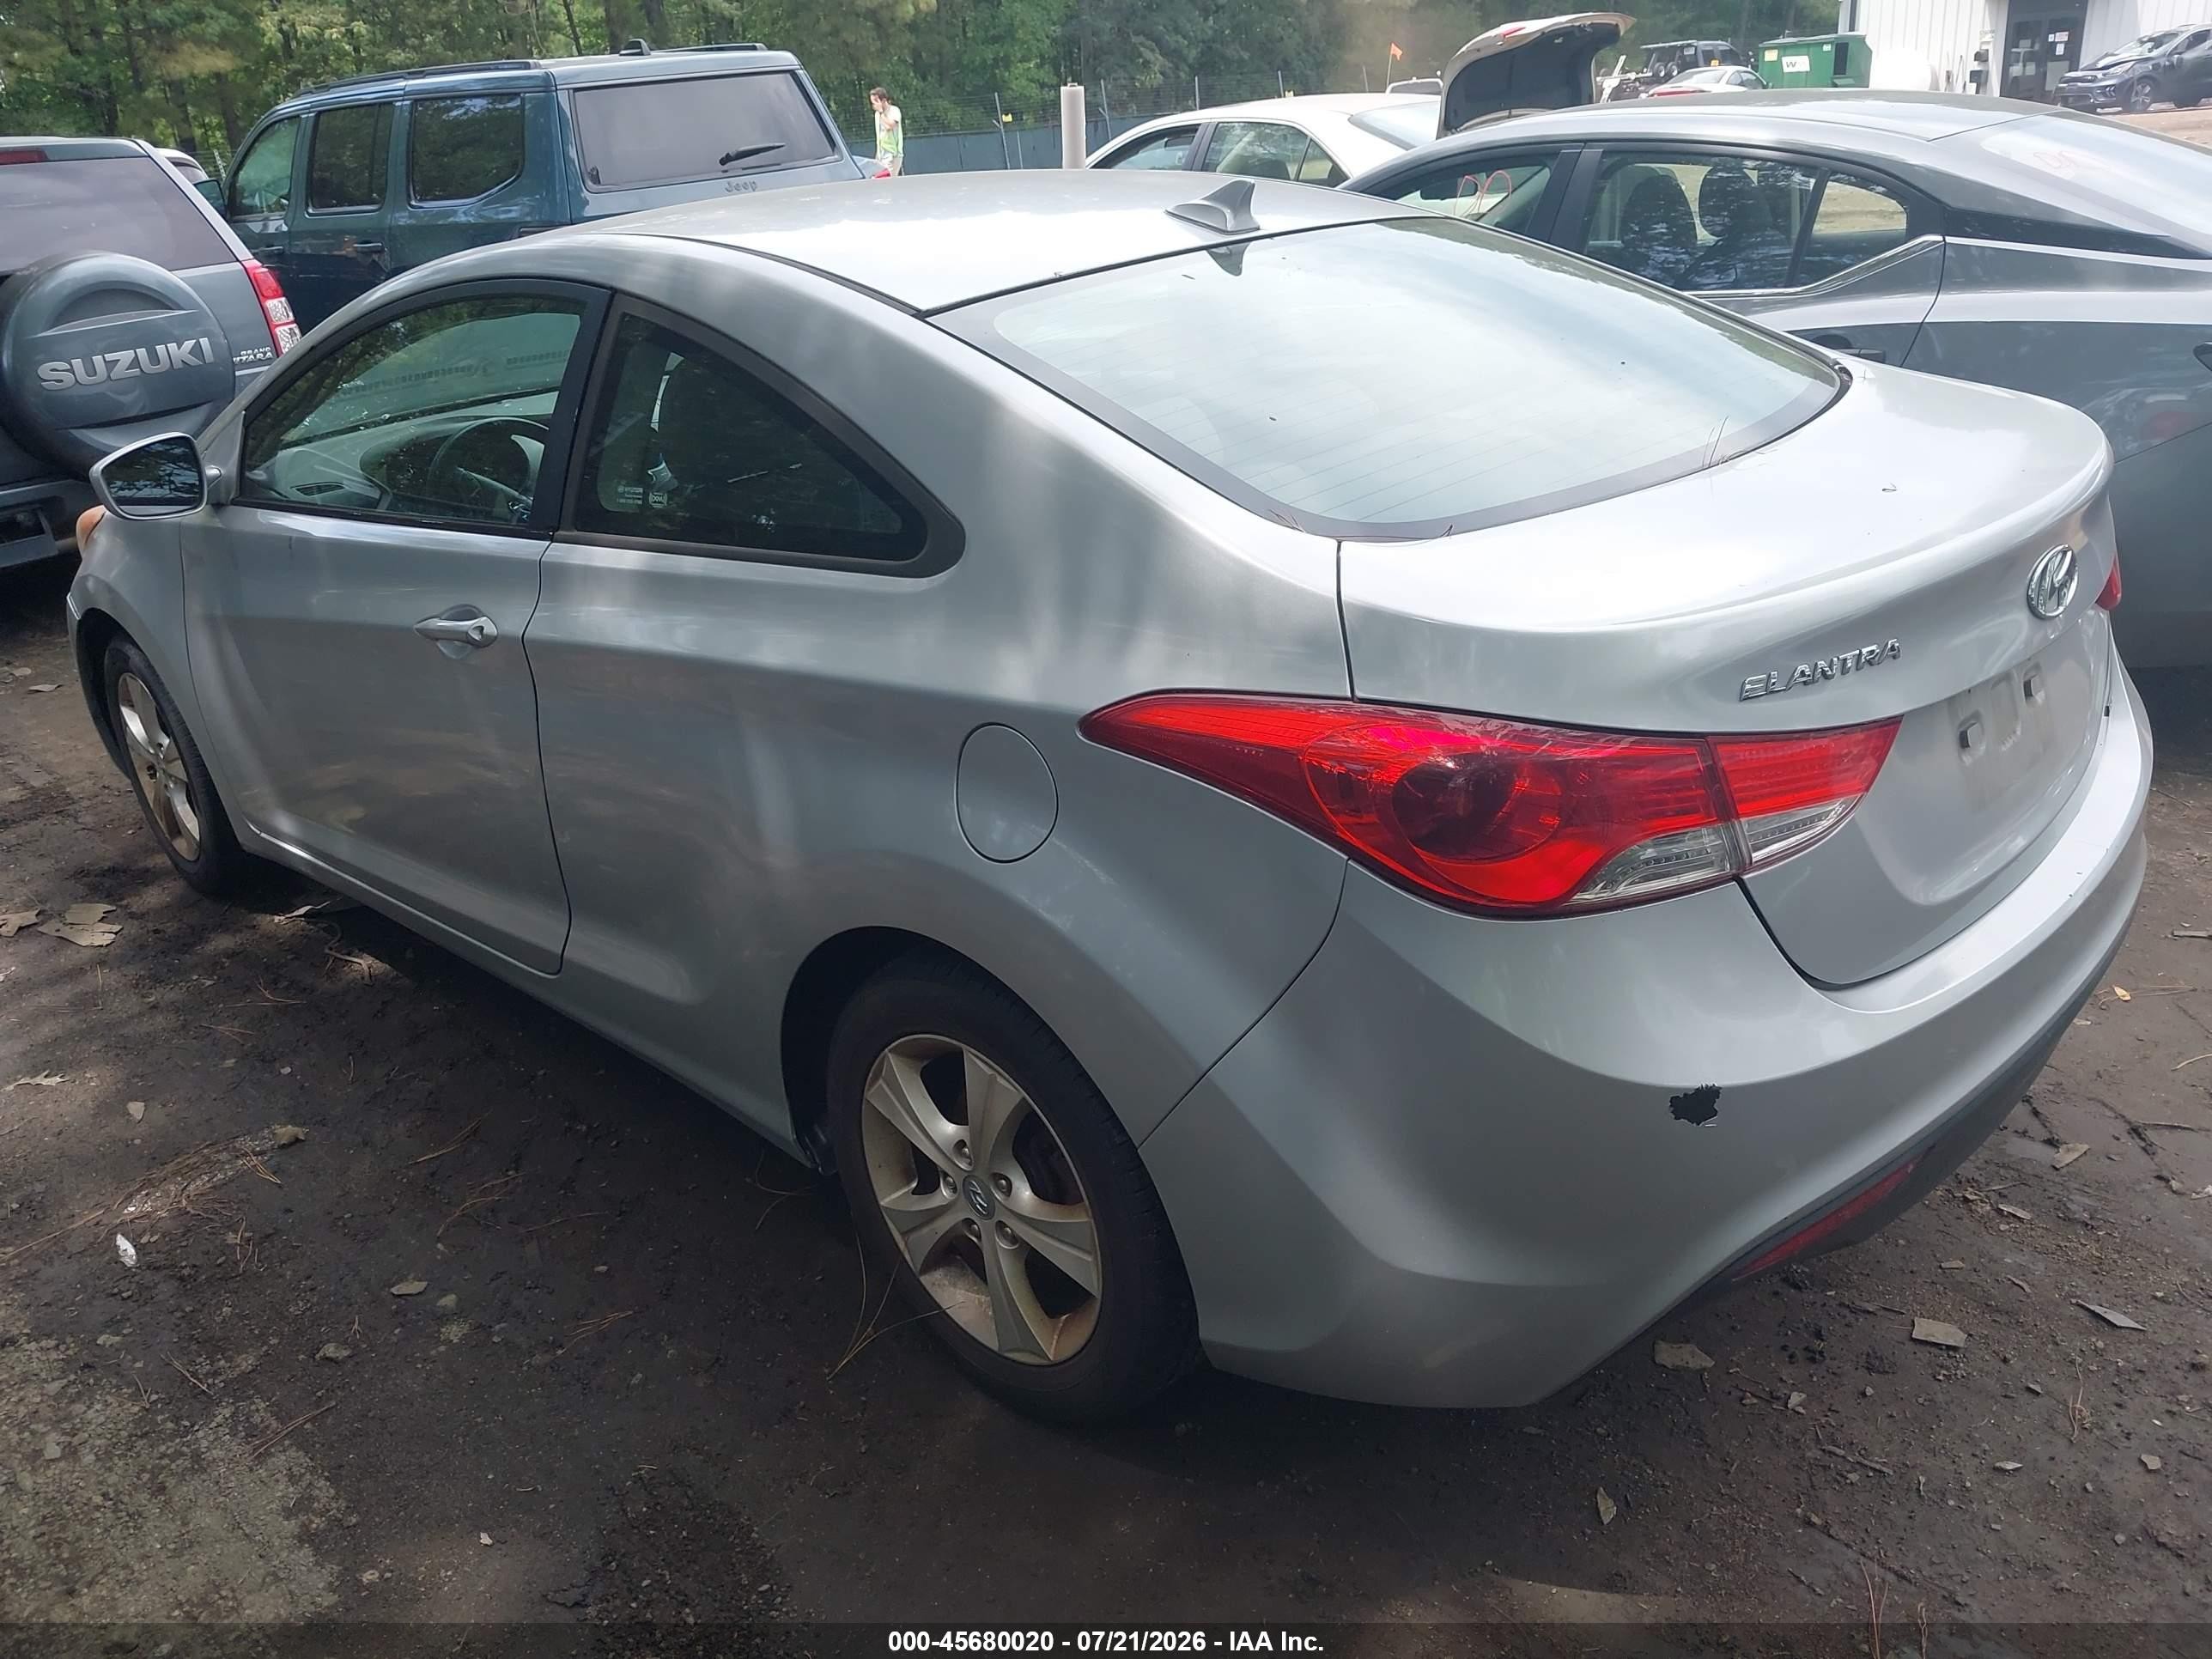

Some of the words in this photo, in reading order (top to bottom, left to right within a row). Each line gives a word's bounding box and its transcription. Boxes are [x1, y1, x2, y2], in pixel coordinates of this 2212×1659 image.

[725, 180, 758, 193] Jeep
[38, 337, 214, 391] SUZUKI
[240, 346, 271, 356] GRAND
[1740, 638, 1901, 702] ELANTRA
